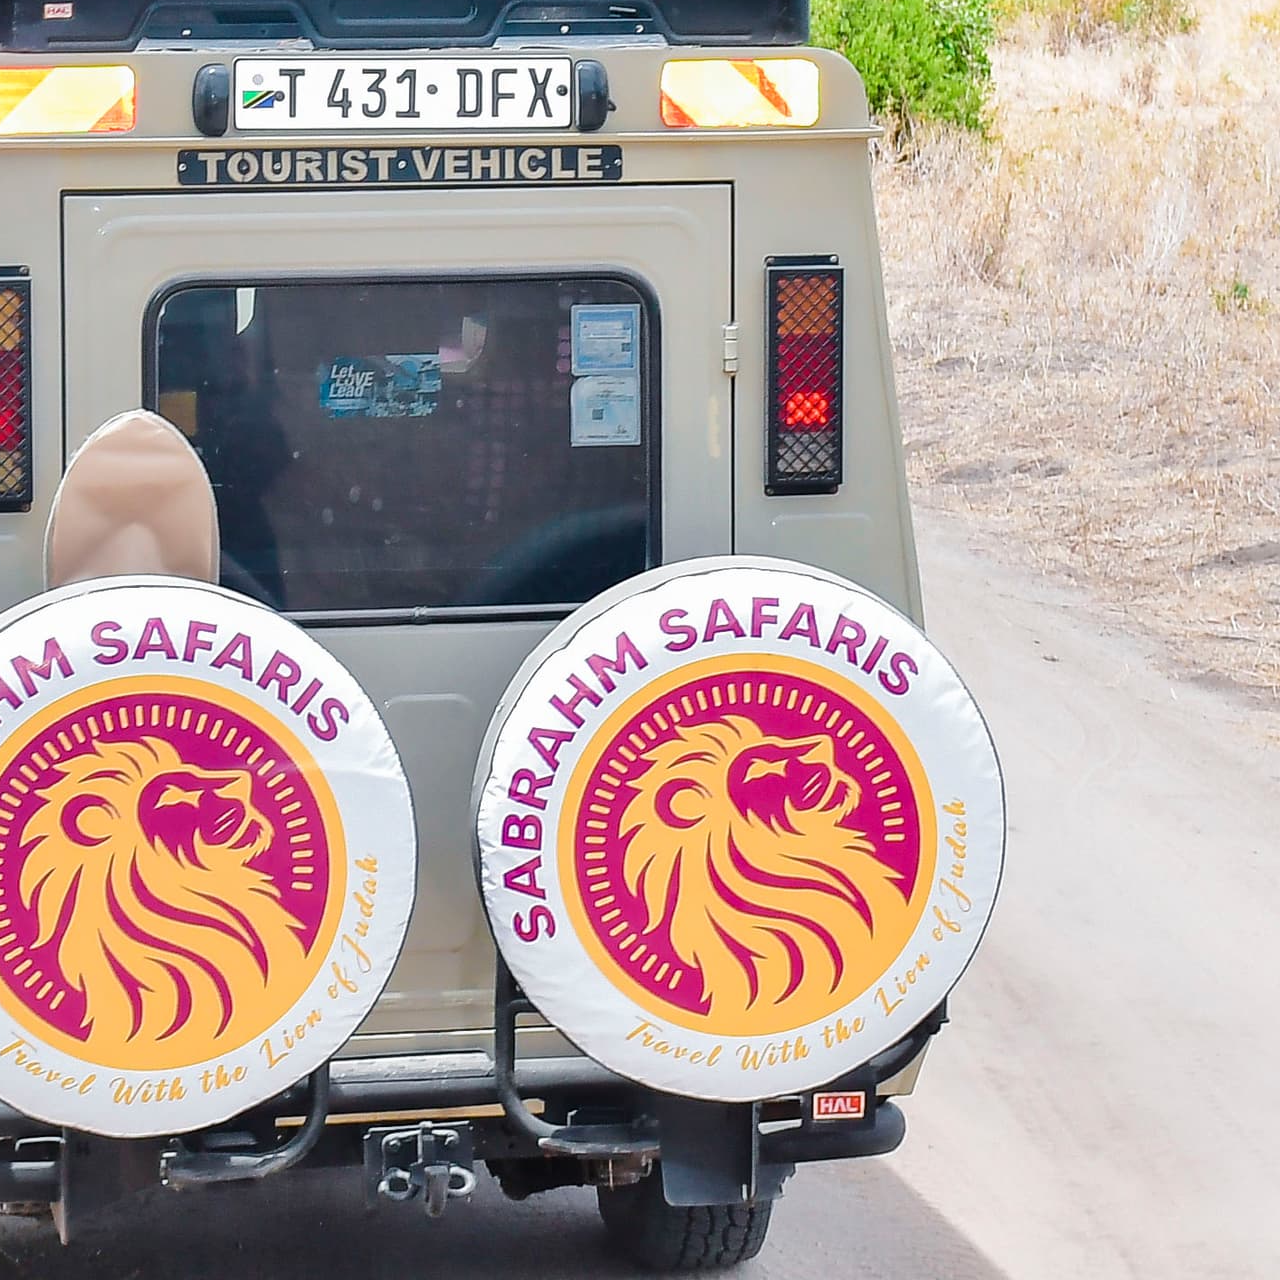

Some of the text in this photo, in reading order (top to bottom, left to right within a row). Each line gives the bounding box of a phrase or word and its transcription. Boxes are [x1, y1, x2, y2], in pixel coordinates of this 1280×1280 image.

[279, 68, 553, 118] T 431 DFX
[199, 147, 604, 183] TOURIST VEHICLE
[329, 382, 366, 399] Lead
[331, 364, 355, 380] Let
[90, 616, 352, 743] SAFARIS
[501, 596, 920, 943] SABRAHM SAFARIS
[339, 853, 379, 974] Judah
[624, 797, 968, 1072] Travel With the Lion of Judah
[327, 960, 359, 1001] of
[258, 1007, 324, 1069] Lion
[108, 1076, 188, 1105] With
[199, 1063, 248, 1094] the
[820, 1097, 859, 1113] HAL
